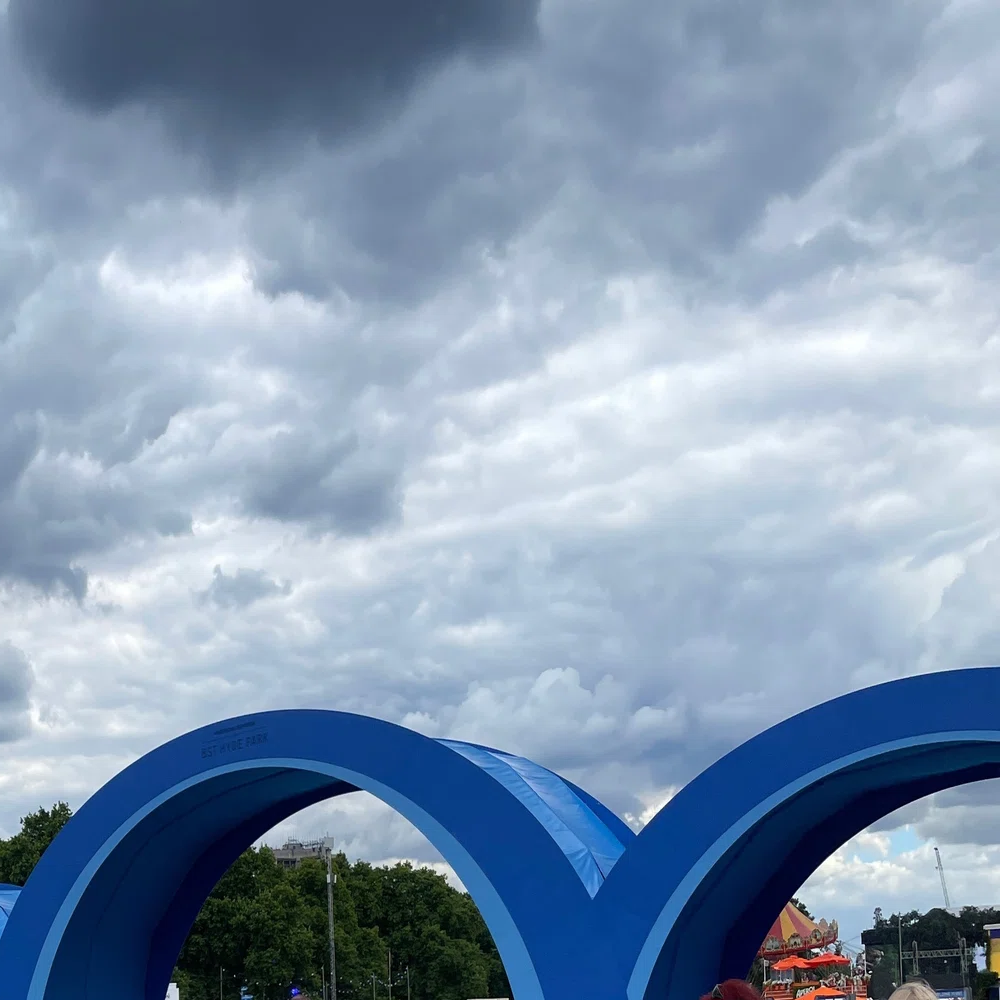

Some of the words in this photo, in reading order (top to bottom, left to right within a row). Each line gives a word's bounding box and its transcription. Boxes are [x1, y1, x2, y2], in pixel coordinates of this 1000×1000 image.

[201, 744, 218, 759] BST
[219, 738, 244, 754] HYDE
[245, 732, 269, 748] PARK
